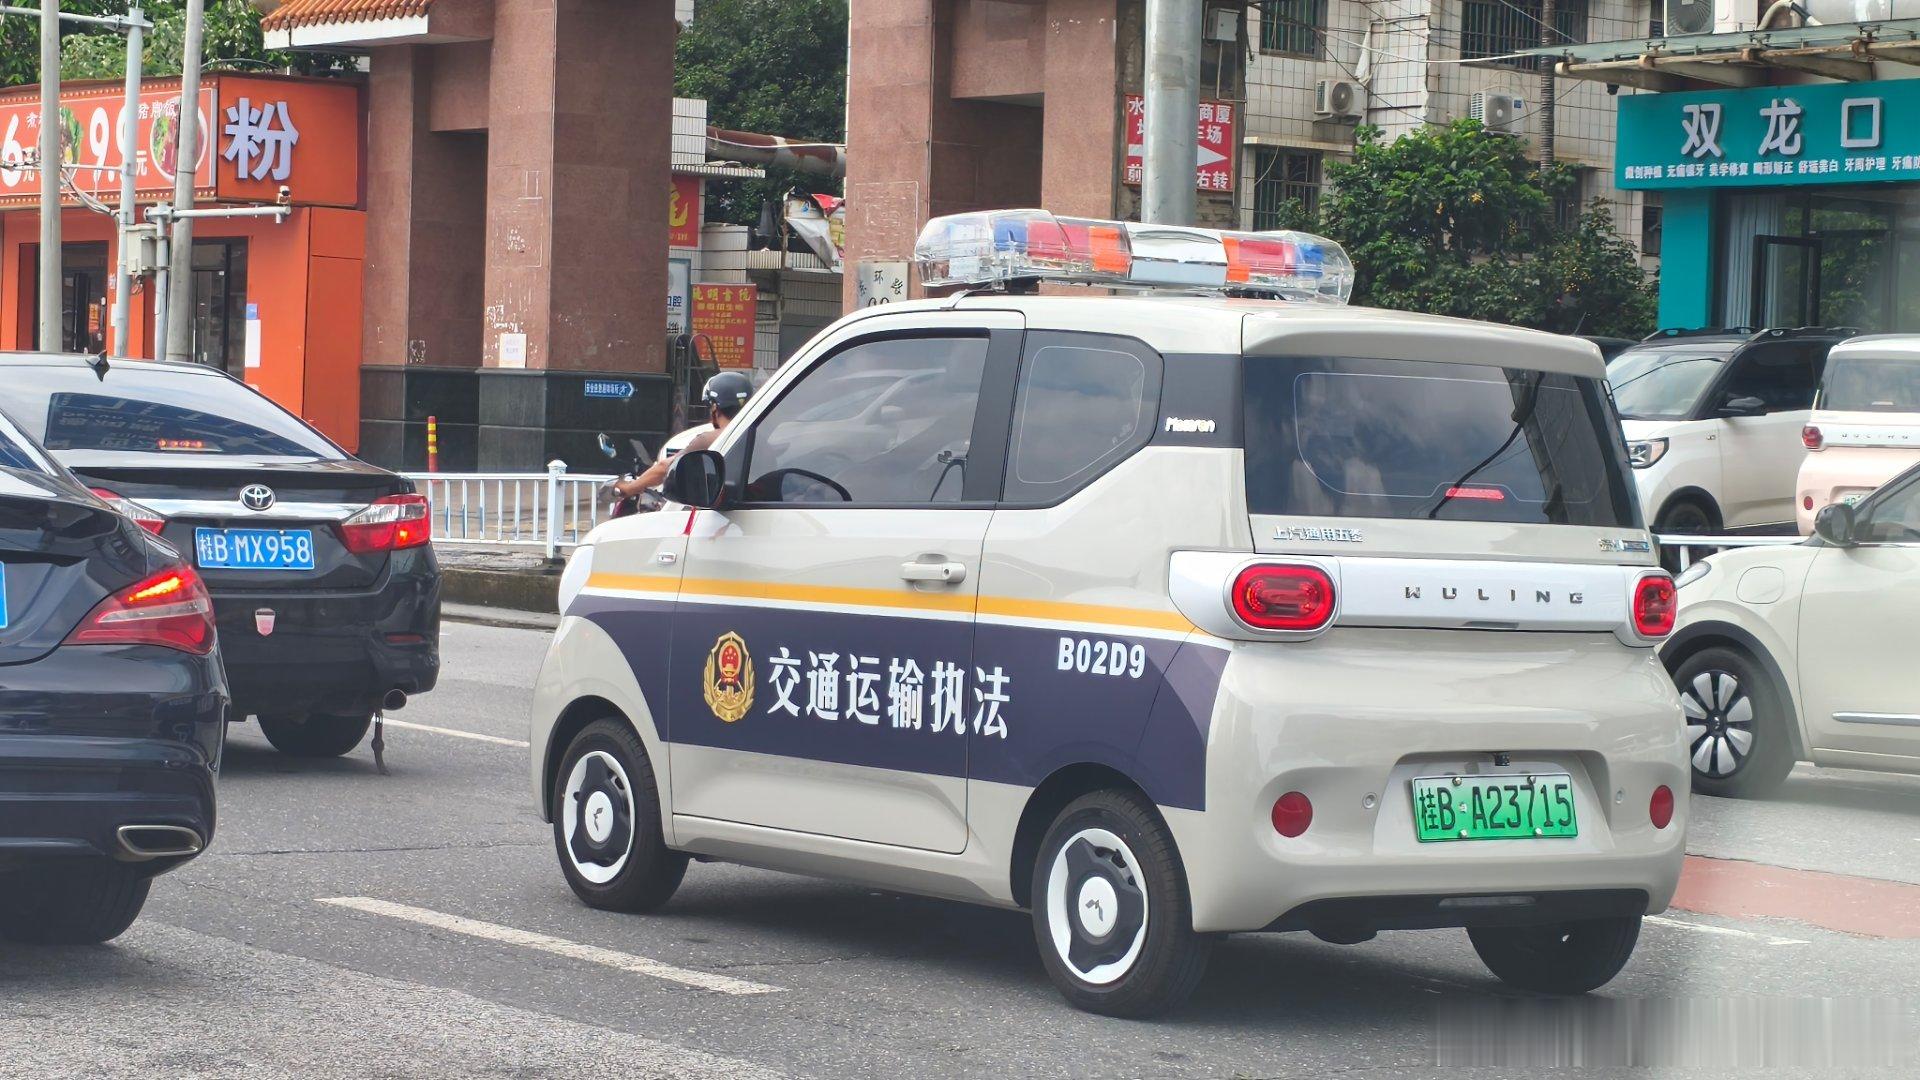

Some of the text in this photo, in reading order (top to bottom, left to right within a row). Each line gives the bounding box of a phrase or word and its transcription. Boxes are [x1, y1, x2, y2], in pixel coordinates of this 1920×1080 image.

[224, 97, 300, 181] 粉
[1681, 97, 1881, 158] 双龙口
[1273, 525, 1363, 542] 上汽通用五菱
[1405, 586, 1584, 604] WULING
[1057, 637, 1146, 679] B02D9
[766, 646, 1011, 739] 交通运输执法
